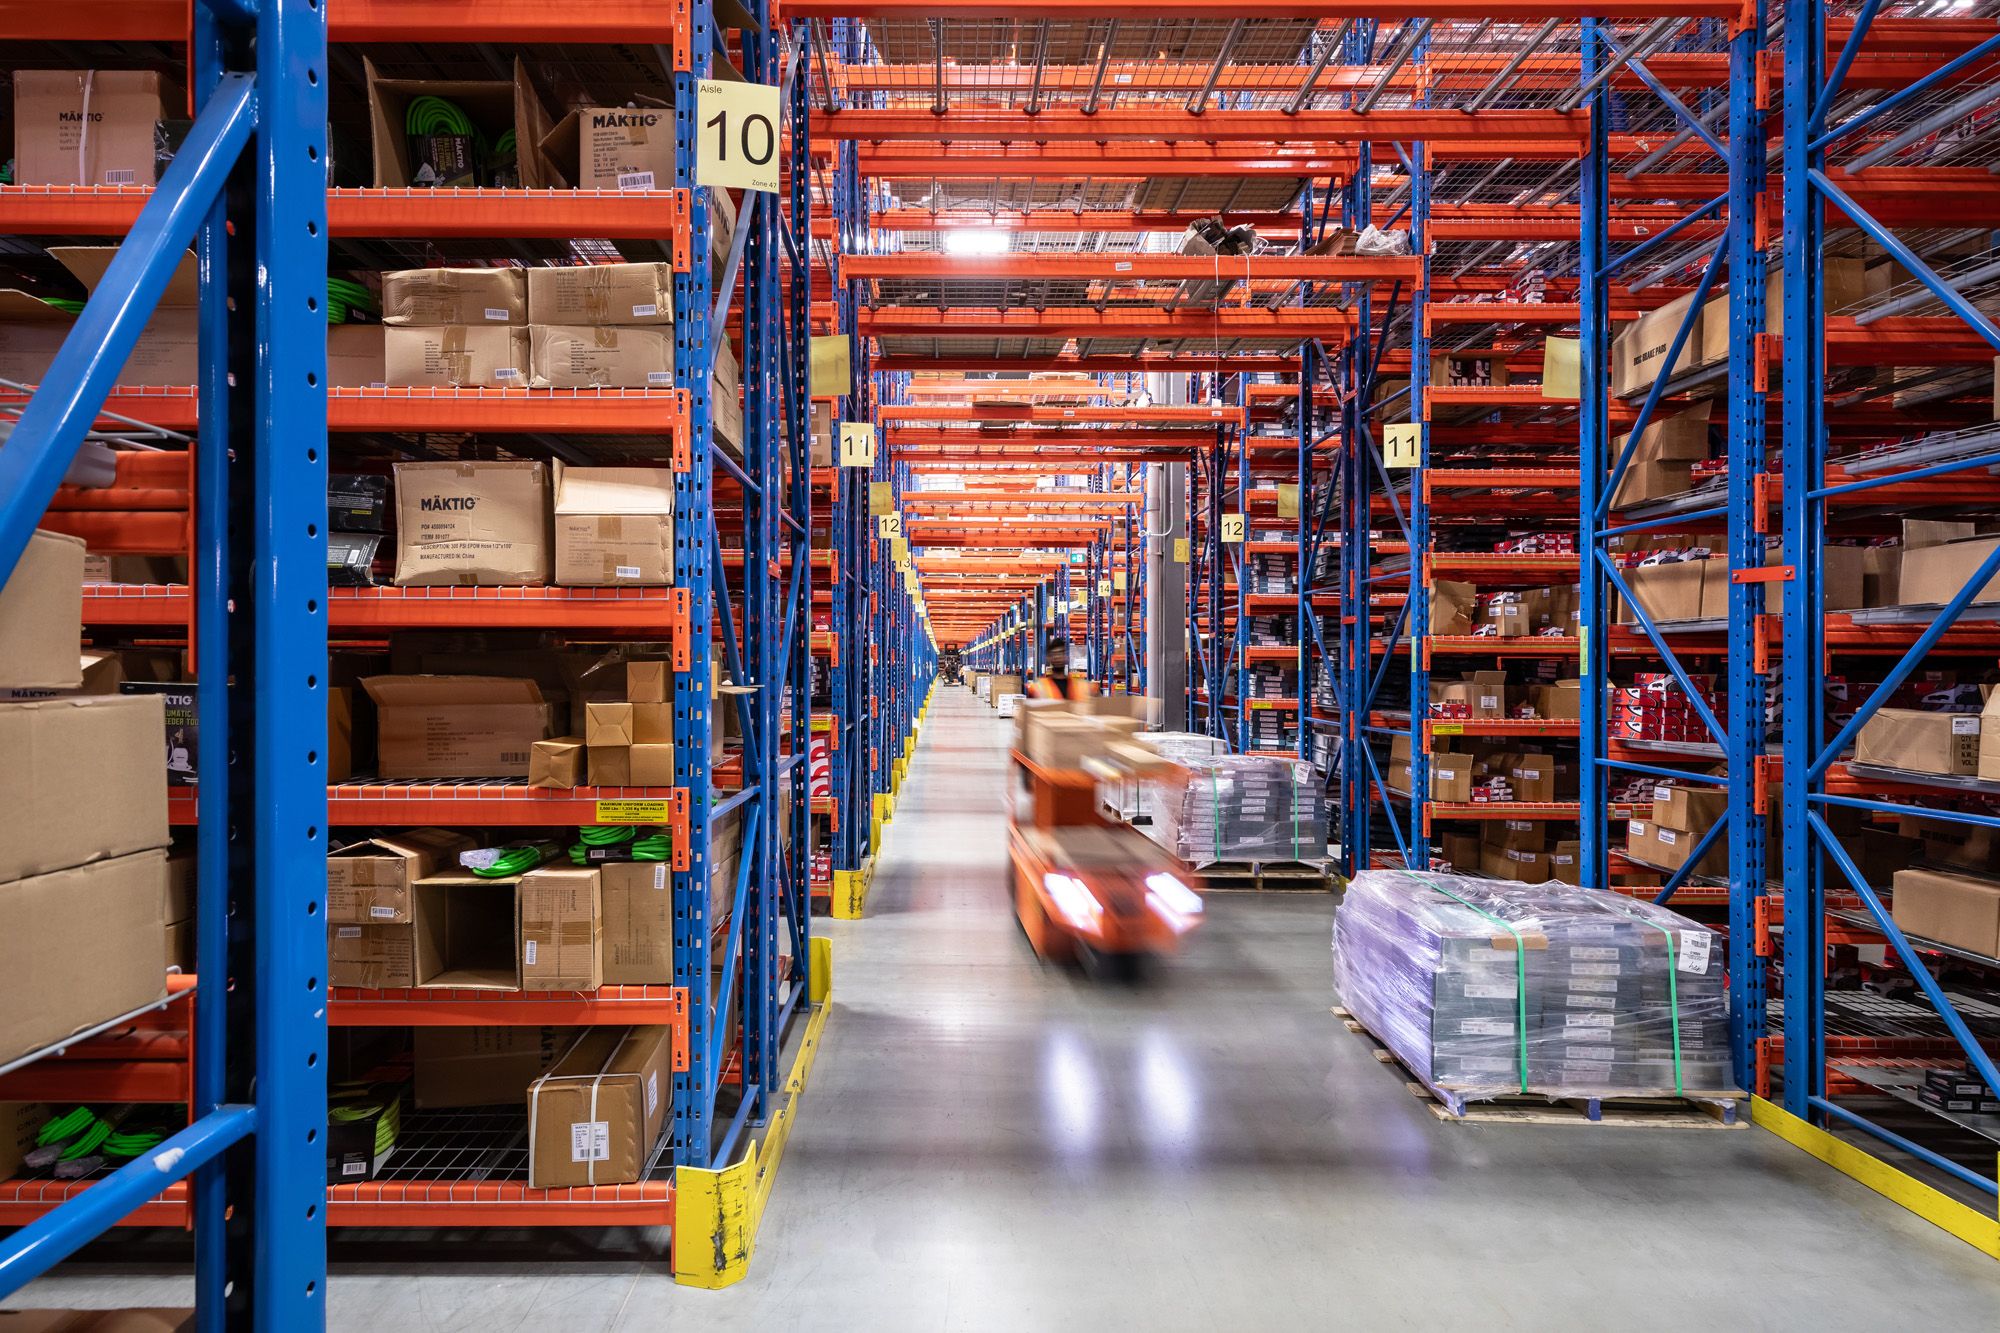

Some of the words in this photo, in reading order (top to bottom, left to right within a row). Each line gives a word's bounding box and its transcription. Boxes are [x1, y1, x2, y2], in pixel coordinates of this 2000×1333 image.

[700, 84, 723, 94] Aisle
[59, 110, 103, 122] MÄKTIG
[592, 112, 658, 129] MÄKTIG
[707, 110, 775, 166] 10
[1642, 347, 1655, 362] BRAKE
[1655, 343, 1667, 356] PADS
[844, 434, 869, 457] 11
[1388, 435, 1415, 457] 11
[420, 495, 476, 511] MÄKTIG
[881, 518, 900, 532] 12
[1224, 521, 1243, 536] 12
[1099, 584, 1110, 593] 14
[165, 695, 193, 705] KTIG
[166, 710, 192, 718] UMATIC
